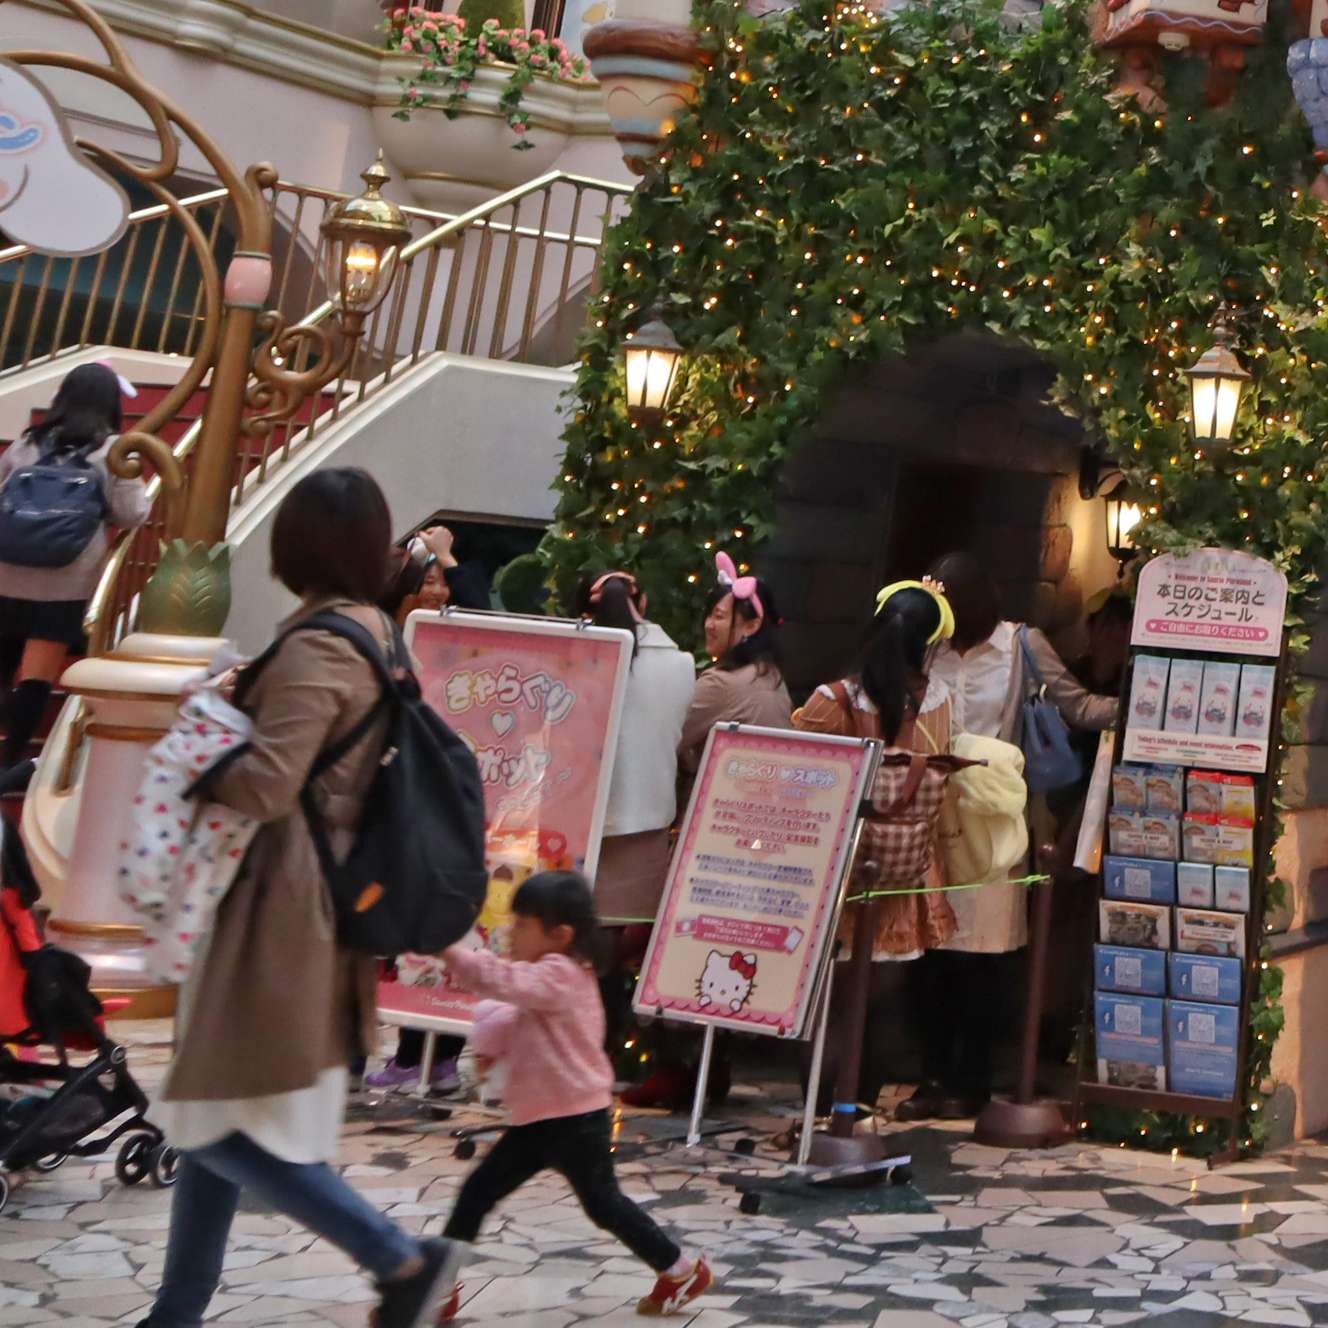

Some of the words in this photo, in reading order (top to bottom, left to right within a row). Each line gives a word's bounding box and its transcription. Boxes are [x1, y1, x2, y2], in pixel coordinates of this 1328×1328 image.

[1157, 583, 1265, 606] 本日のご案内と
[1165, 602, 1254, 622] スケジュール
[447, 664, 575, 724] きゃらぐり
